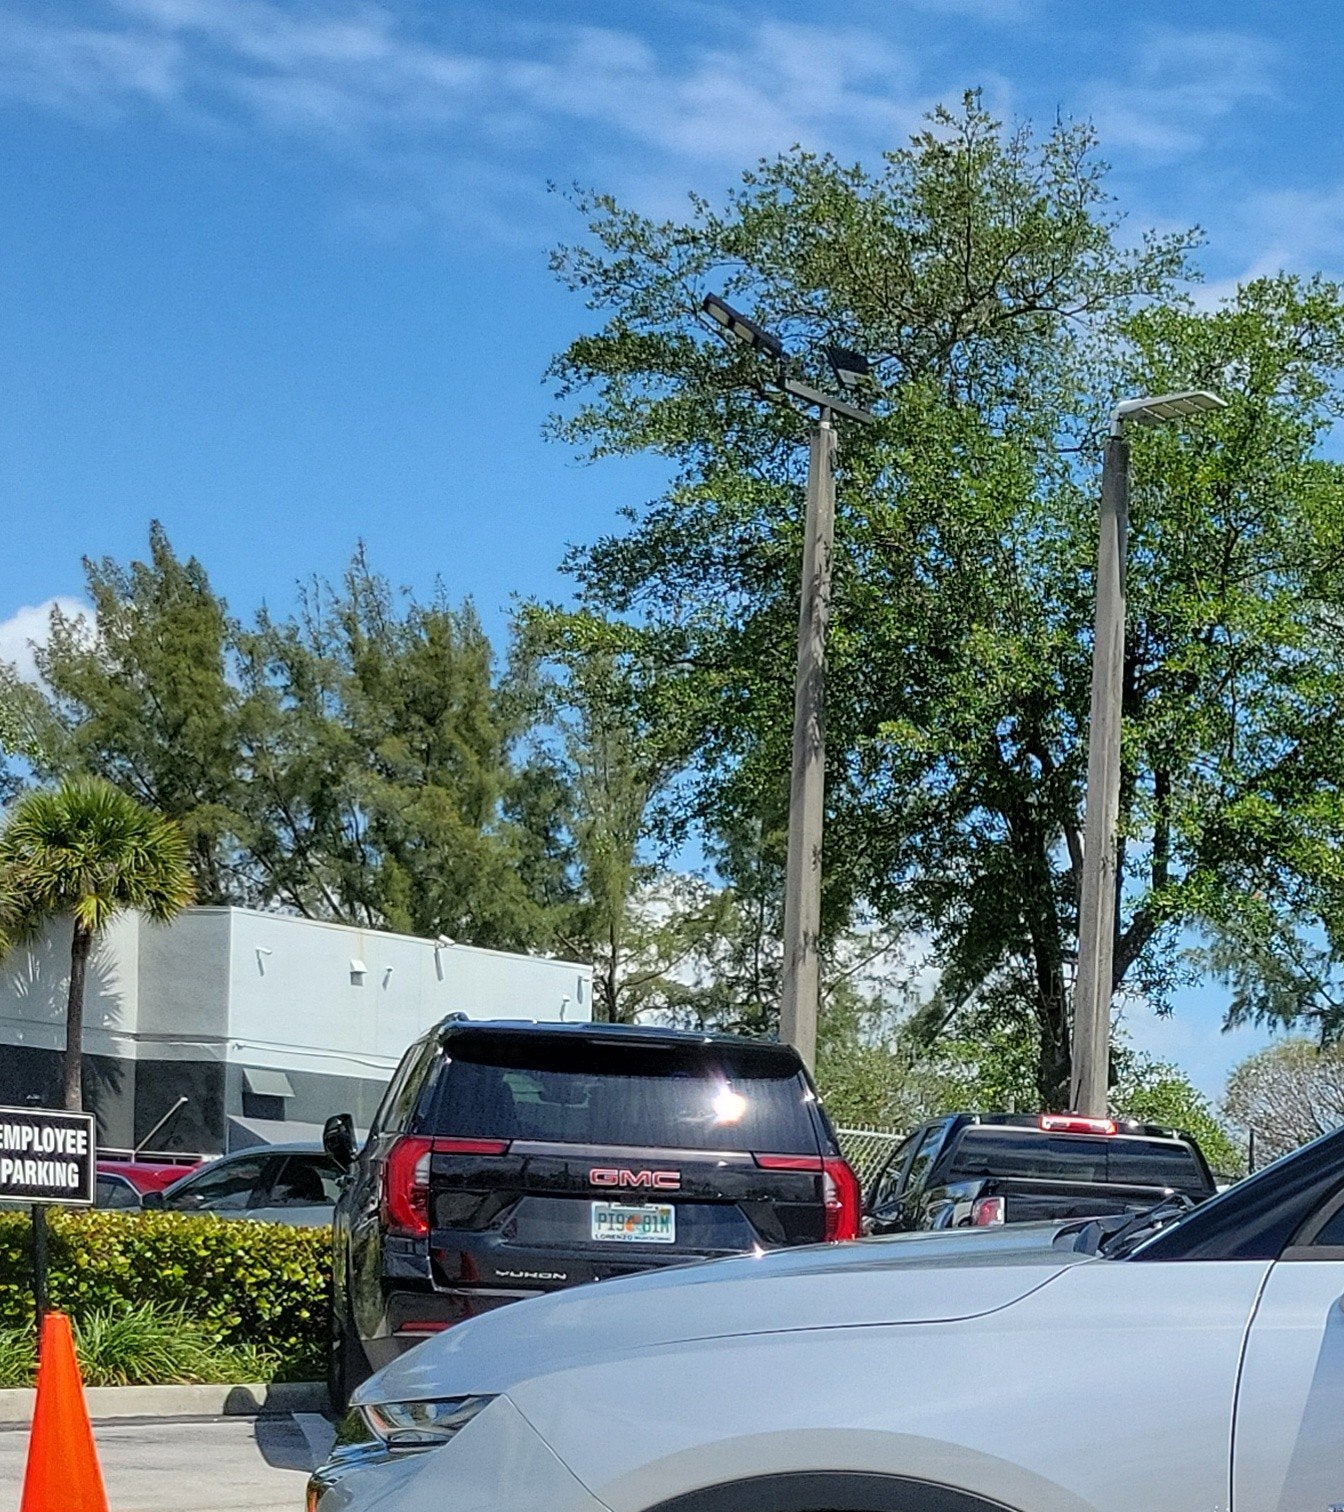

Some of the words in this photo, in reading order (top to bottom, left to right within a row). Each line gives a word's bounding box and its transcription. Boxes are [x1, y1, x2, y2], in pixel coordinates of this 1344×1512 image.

[1, 1158, 79, 1188] PARKING
[589, 1168, 681, 1189] GMC
[495, 1269, 567, 1280] YUKON
